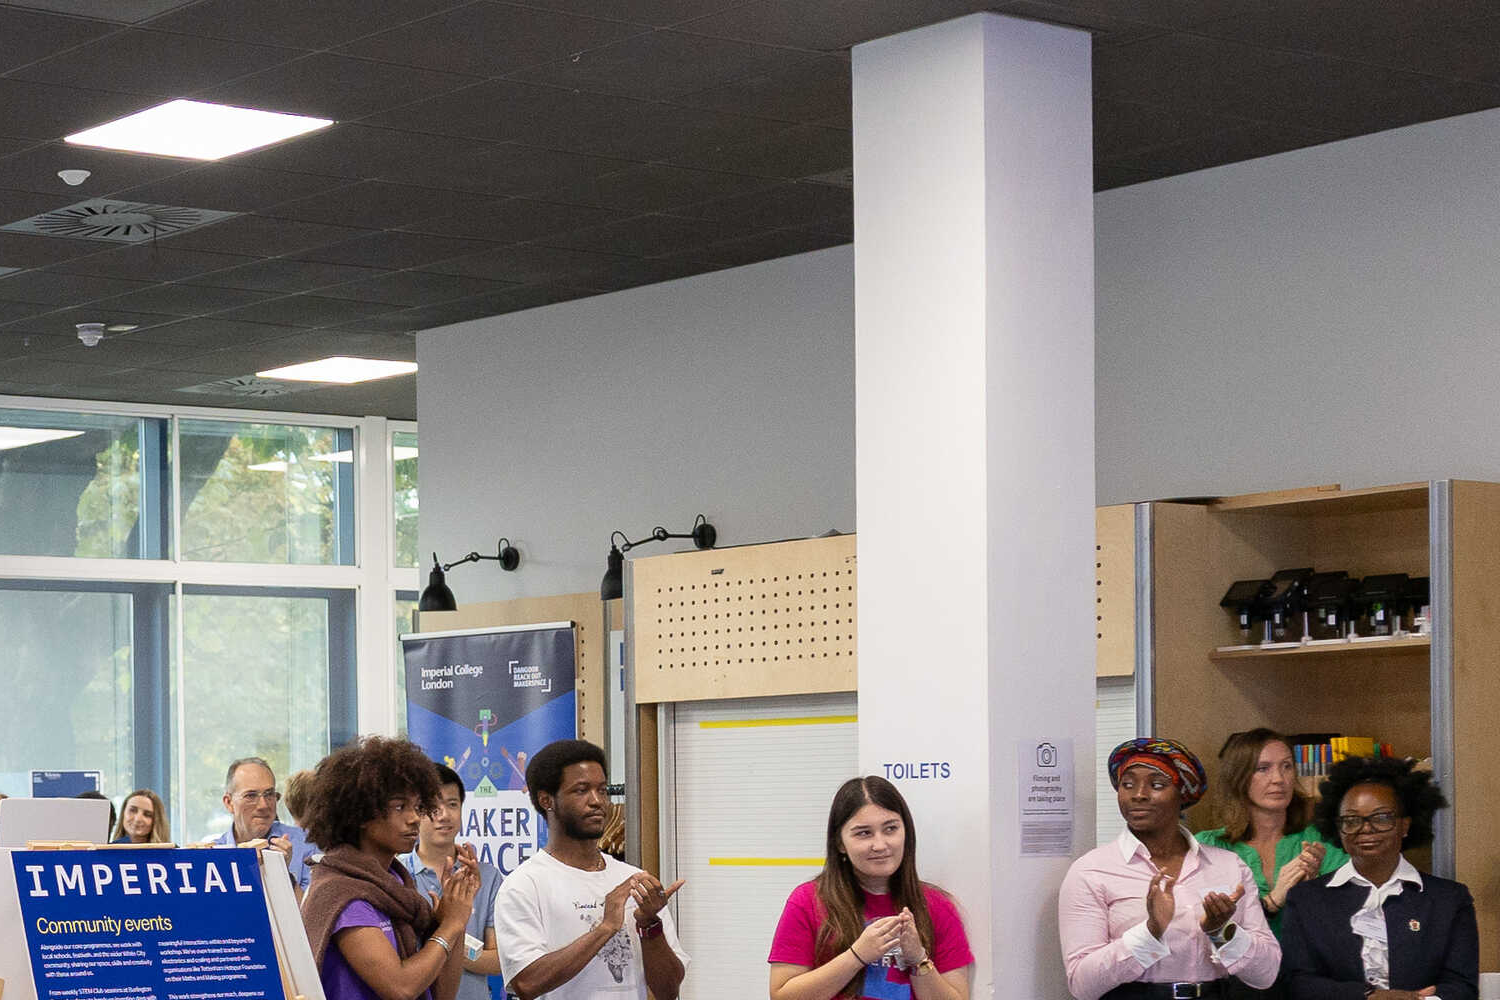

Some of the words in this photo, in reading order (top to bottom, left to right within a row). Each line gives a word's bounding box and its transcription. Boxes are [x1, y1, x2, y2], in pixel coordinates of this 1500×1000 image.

[421, 665, 453, 678] Imperial
[455, 664, 483, 677] College
[421, 679, 453, 690] London
[514, 679, 546, 688] MAKERSPACE
[884, 762, 950, 780] TOILETS
[1031, 786, 1062, 794] photography
[460, 808, 531, 837] AKER
[25, 862, 252, 897] IMPERIAL
[36, 916, 121, 936] Community
[125, 915, 172, 931] events
